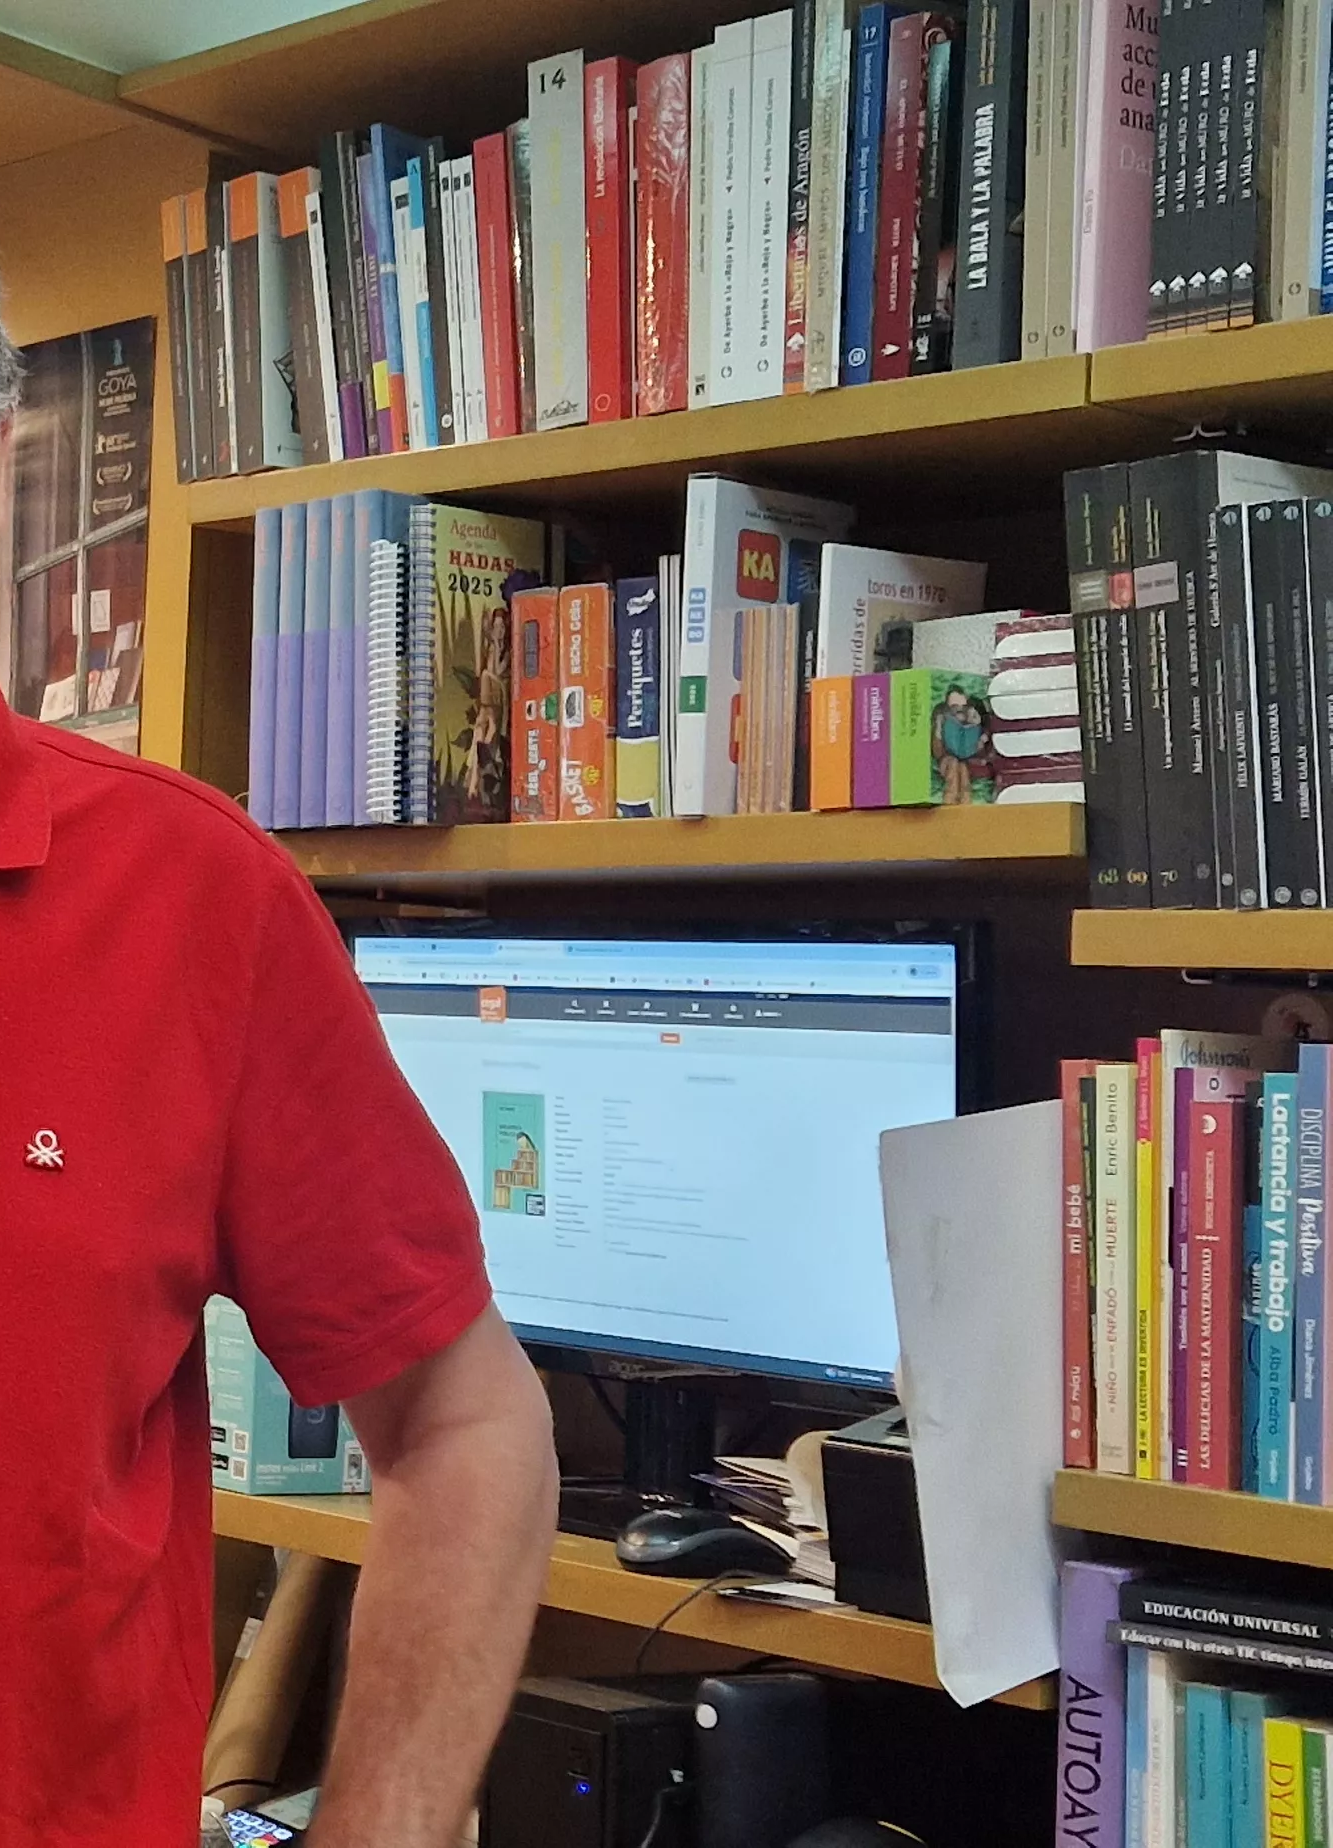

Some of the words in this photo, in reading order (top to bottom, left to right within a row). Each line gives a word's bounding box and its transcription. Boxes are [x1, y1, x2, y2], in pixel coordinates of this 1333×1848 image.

[865, 26, 876, 40] 17
[1121, 67, 1145, 97] de
[973, 103, 995, 178] PALABRA
[792, 128, 810, 196] Aragón
[972, 180, 992, 202] LA
[790, 198, 807, 222] de
[970, 206, 990, 219] Y
[968, 221, 989, 264] BALA
[967, 267, 987, 290] LA
[98, 373, 137, 396] GOYA
[450, 518, 497, 541] Agenda
[449, 549, 515, 573] HADAS
[742, 548, 776, 582] KA
[448, 573, 493, 597] 2025
[899, 585, 914, 599] en
[626, 627, 653, 729] Periquetes
[1104, 1083, 1118, 1134] Benito
[1104, 1139, 1118, 1177] Enric
[1271, 1092, 1292, 1213] Lactancia
[1300, 1108, 1324, 1189] DISCIPLINA
[1067, 1233, 1081, 1254] mi
[1105, 1198, 1118, 1258] MUERTE
[1265, 1218, 1287, 1236] y
[1296, 1198, 1324, 1278] Positiva
[1200, 1247, 1212, 1338] MATERNIDAD
[1265, 1239, 1290, 1333] trabajo
[1102, 1287, 1118, 1343] ENFADÓ
[1200, 1340, 1212, 1358] LA
[1268, 1345, 1283, 1383] Alba
[1200, 1360, 1212, 1379] DE
[1199, 1381, 1211, 1442] DELICIAS
[1199, 1444, 1211, 1470] LAS
[1142, 1600, 1230, 1626] EDUCACIÓN
[1232, 1614, 1321, 1639] UNIVERSAL
